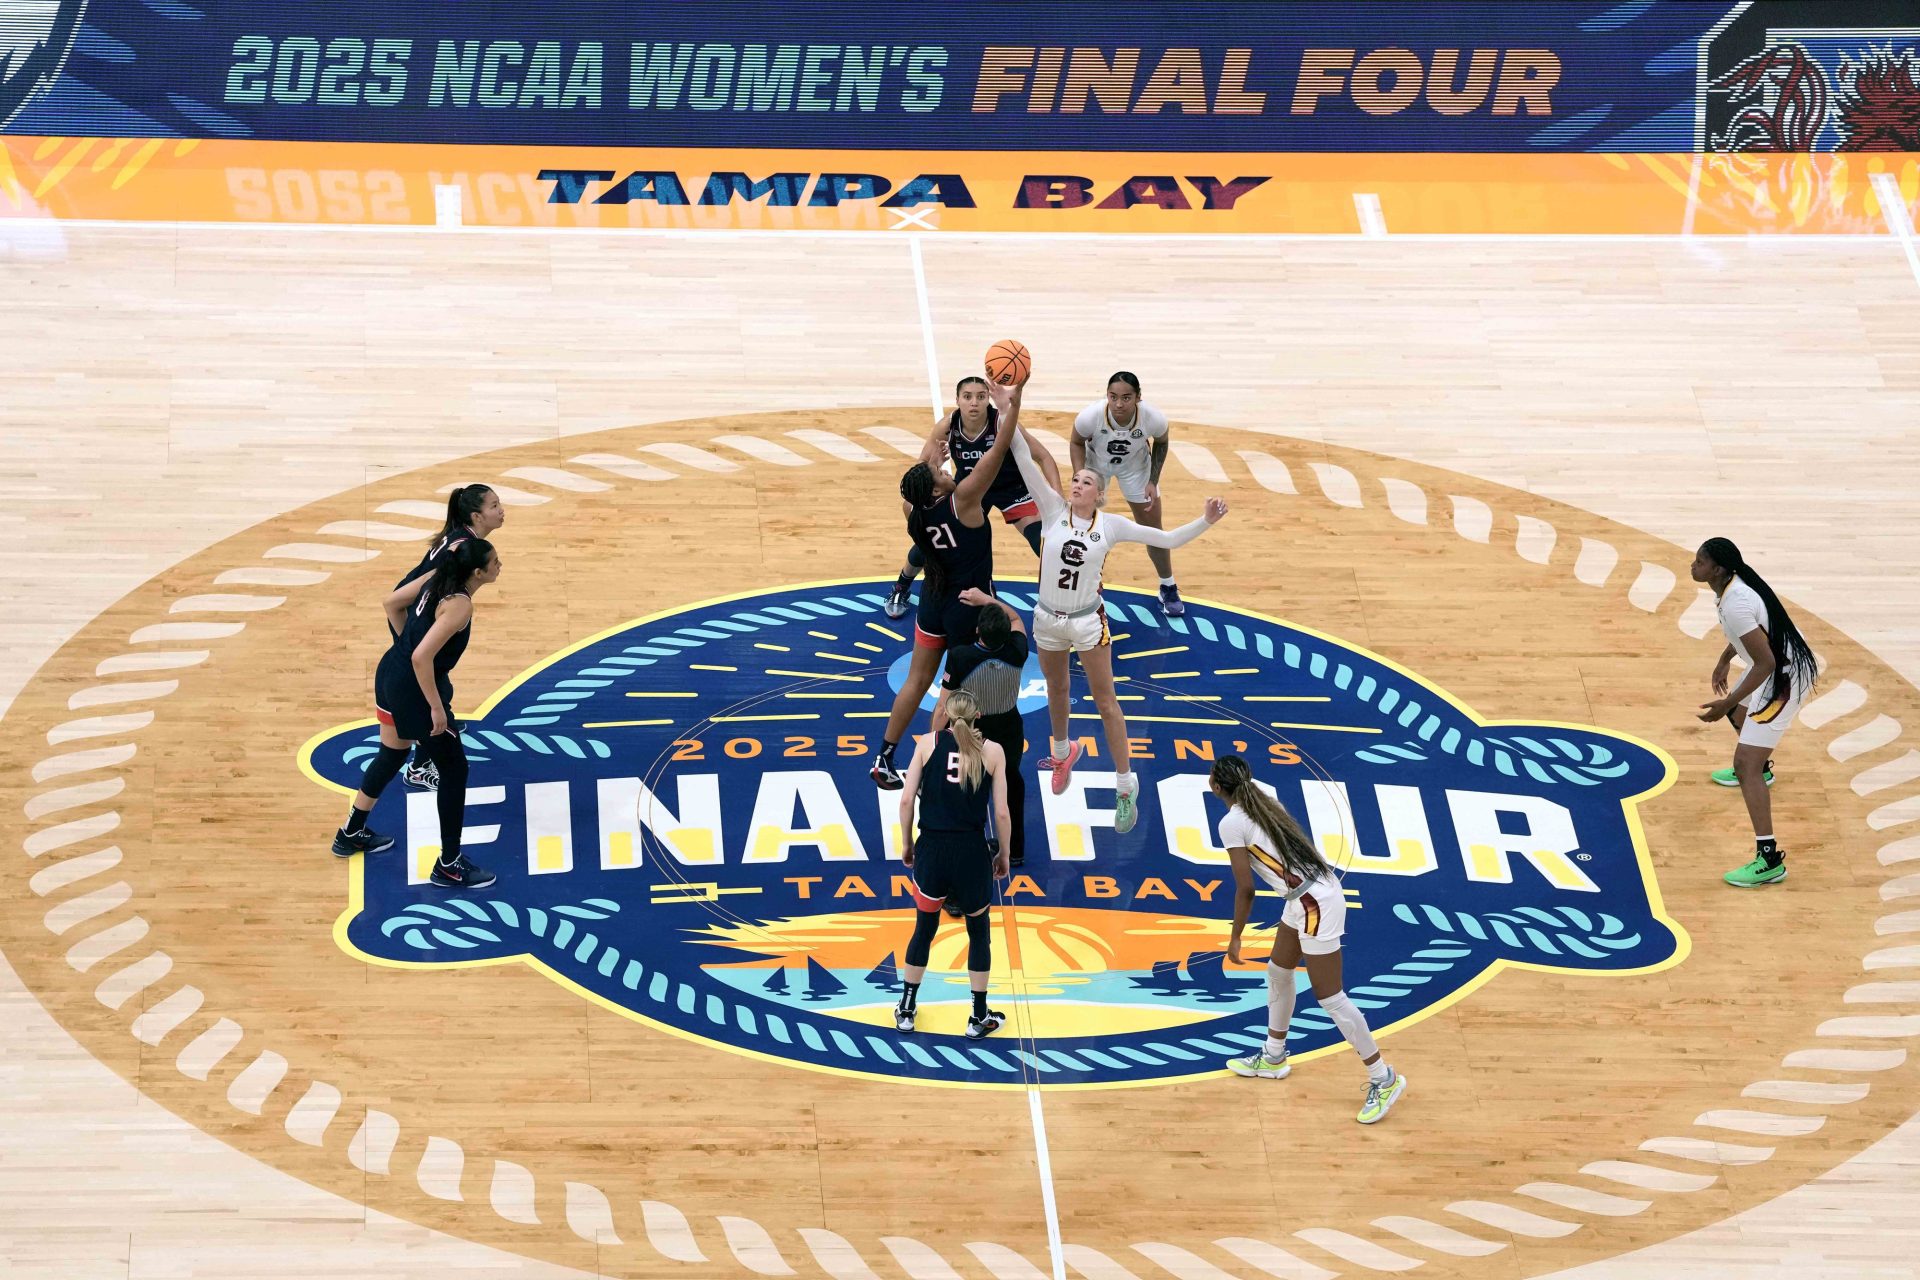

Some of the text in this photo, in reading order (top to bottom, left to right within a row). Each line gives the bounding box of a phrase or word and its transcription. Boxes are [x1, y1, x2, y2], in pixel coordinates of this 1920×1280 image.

[223, 36, 1563, 116] 2025 NCAA WOMEN'S FINAL FOUR
[537, 170, 1272, 209] TAMPA BAY
[956, 450, 988, 460] UCON
[926, 523, 958, 550] 21
[1058, 568, 1080, 591] 21
[673, 735, 868, 760] 2025
[946, 751, 962, 784] 5
[1084, 876, 1223, 901] BAY
